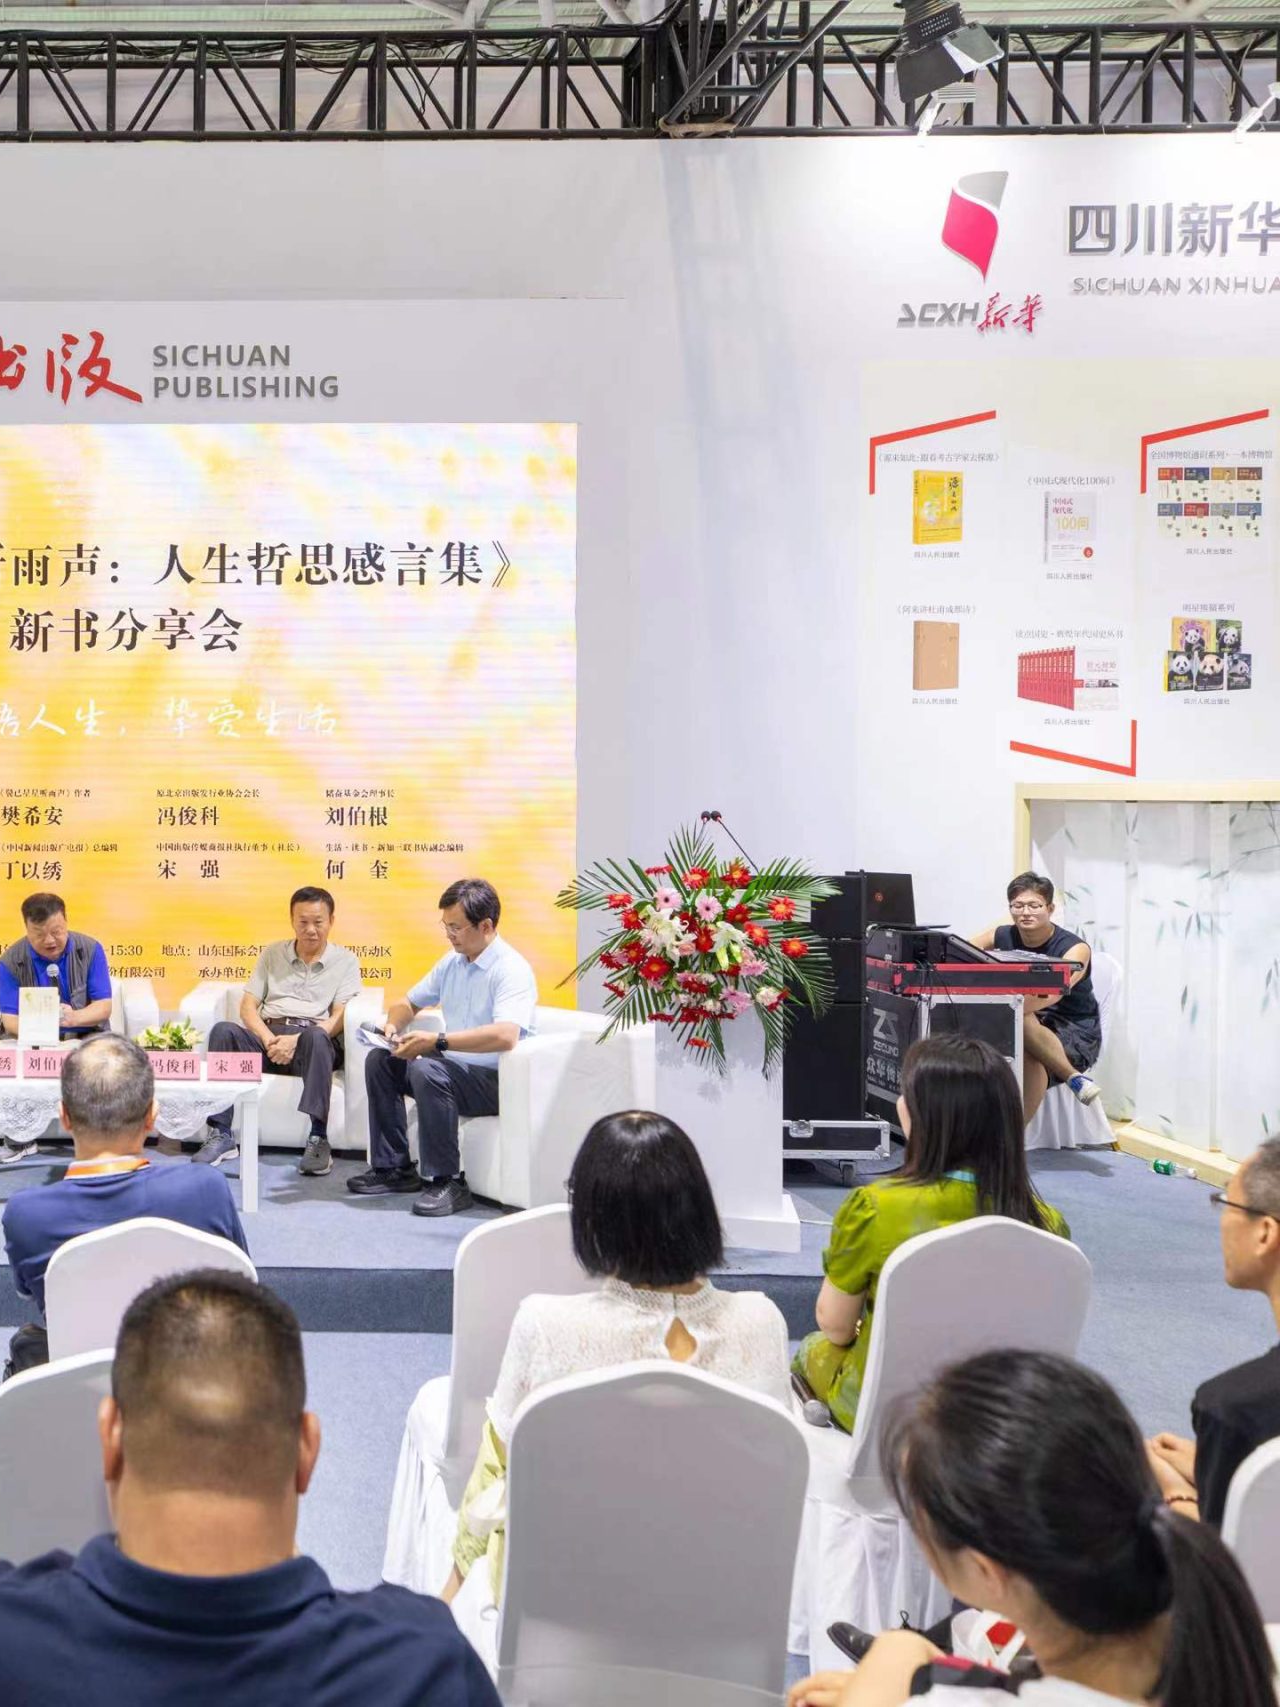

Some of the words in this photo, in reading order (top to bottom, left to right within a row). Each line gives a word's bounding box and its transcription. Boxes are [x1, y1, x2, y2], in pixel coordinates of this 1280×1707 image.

[1068, 201, 1280, 256] 四川新华
[1072, 277, 1181, 294] SICHUAN
[1188, 277, 1280, 293] XINHUA
[152, 344, 291, 368] SICHUAN
[153, 375, 339, 399] PUBLISHING
[9, 607, 244, 653] 新书分享会
[1, 806, 63, 826] 樊希安
[157, 806, 220, 826] 冯俊科
[325, 806, 388, 827] 刘伯根
[1, 860, 63, 882] 丁以绣
